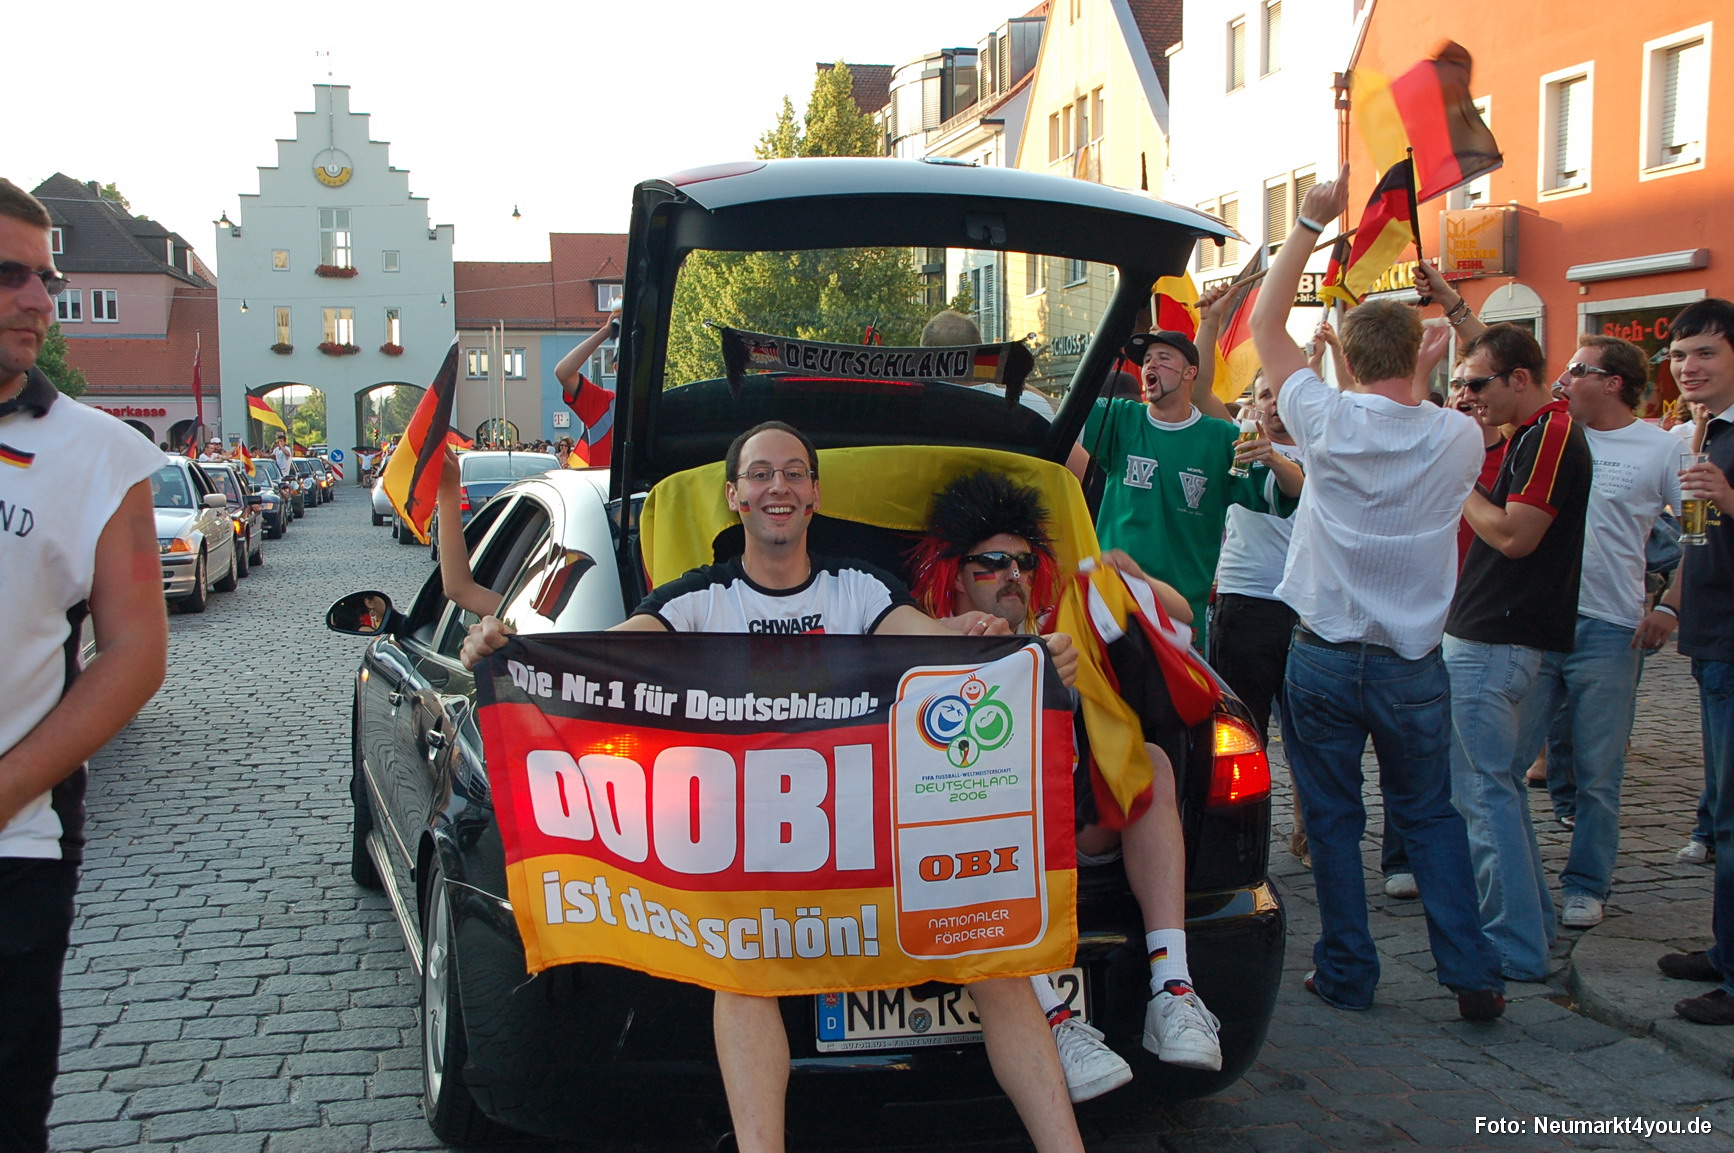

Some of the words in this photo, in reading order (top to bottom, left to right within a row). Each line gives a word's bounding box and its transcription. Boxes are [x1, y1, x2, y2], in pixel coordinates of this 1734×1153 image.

[1603, 317, 1671, 341] Steh-C
[785, 342, 969, 378] DEUTSCHLAND
[747, 613, 824, 634] CHWARZ
[507, 659, 552, 697] Die
[634, 682, 678, 717] für
[685, 690, 879, 722] Deutschland:
[915, 774, 1018, 794] DEUTSCHLAND
[949, 790, 988, 803] 2006
[918, 846, 1019, 883] OBI
[542, 870, 617, 927] ist
[620, 887, 698, 949] das
[697, 904, 880, 961] schön!
[928, 909, 1010, 929] NATIONALER
[935, 926, 1005, 945] FÖRDERER
[848, 990, 905, 1032] NM
[827, 1016, 837, 1030] D
[841, 1040, 886, 1049] AUTOHAUS
